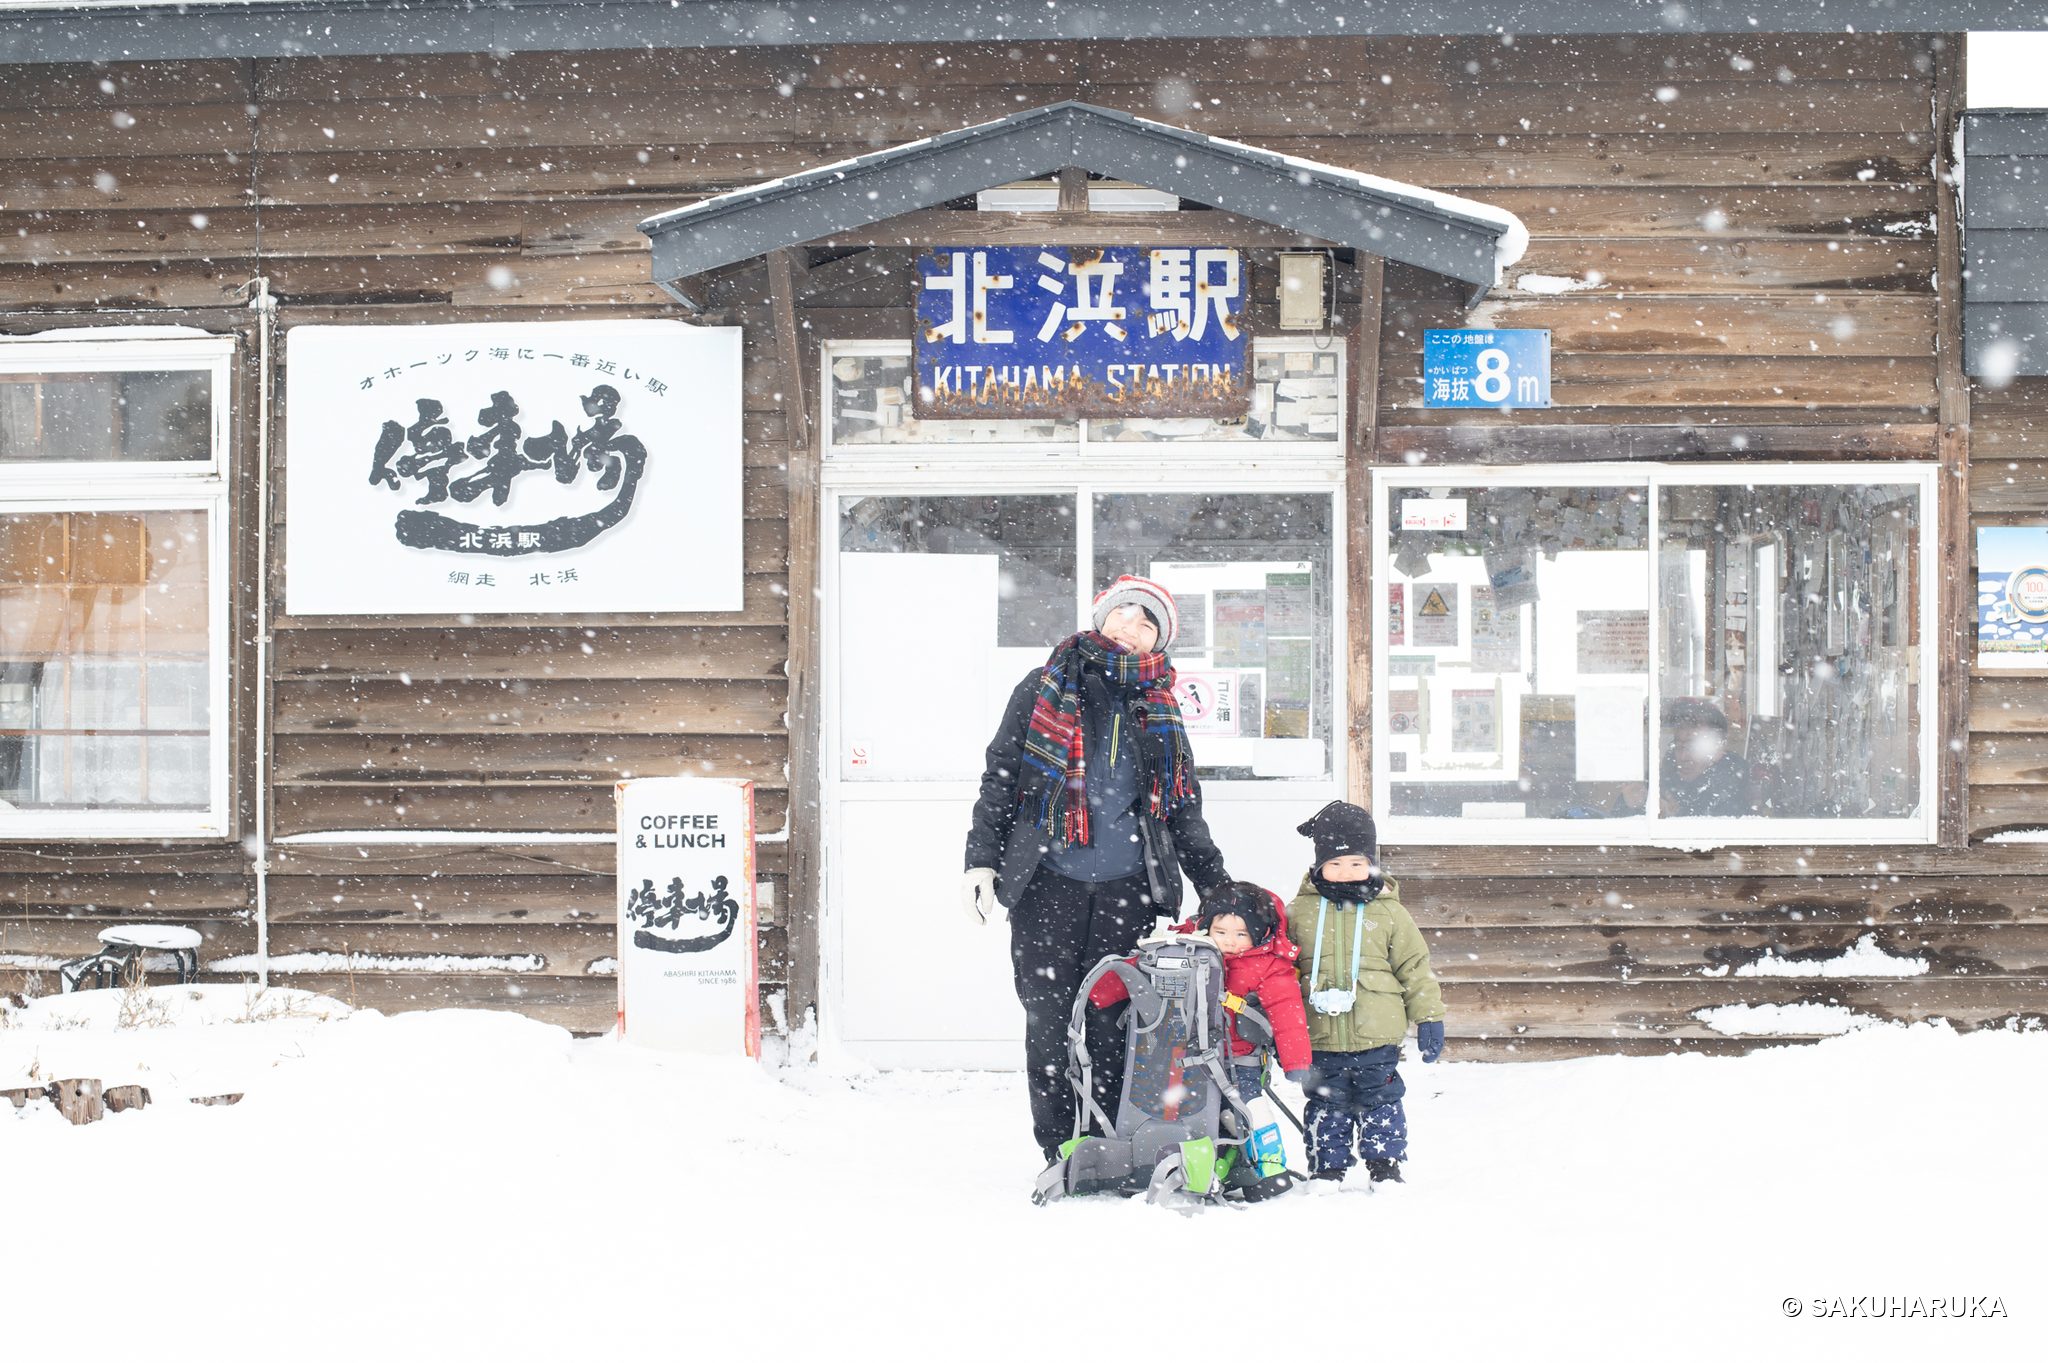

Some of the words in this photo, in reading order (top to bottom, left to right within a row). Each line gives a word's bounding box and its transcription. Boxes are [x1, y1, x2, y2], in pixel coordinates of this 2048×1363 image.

[925, 248, 1241, 344] 北浜駅
[359, 346, 669, 398] オホーツク海に一番近い駅
[933, 364, 1083, 404] KITAHAMA
[1106, 364, 1232, 403] STATION
[368, 384, 649, 557] 停車場
[459, 531, 542, 549] 北浜駅
[447, 570, 496, 587] 網走
[529, 568, 579, 587] 北浜
[640, 814, 718, 831] COFFEE
[635, 834, 648, 849] &
[654, 833, 726, 849] LUNCH
[626, 875, 740, 954] 停車場
[698, 969, 737, 977] KITAHAMA
[698, 977, 719, 985] SINCE
[720, 977, 737, 985] 1986
